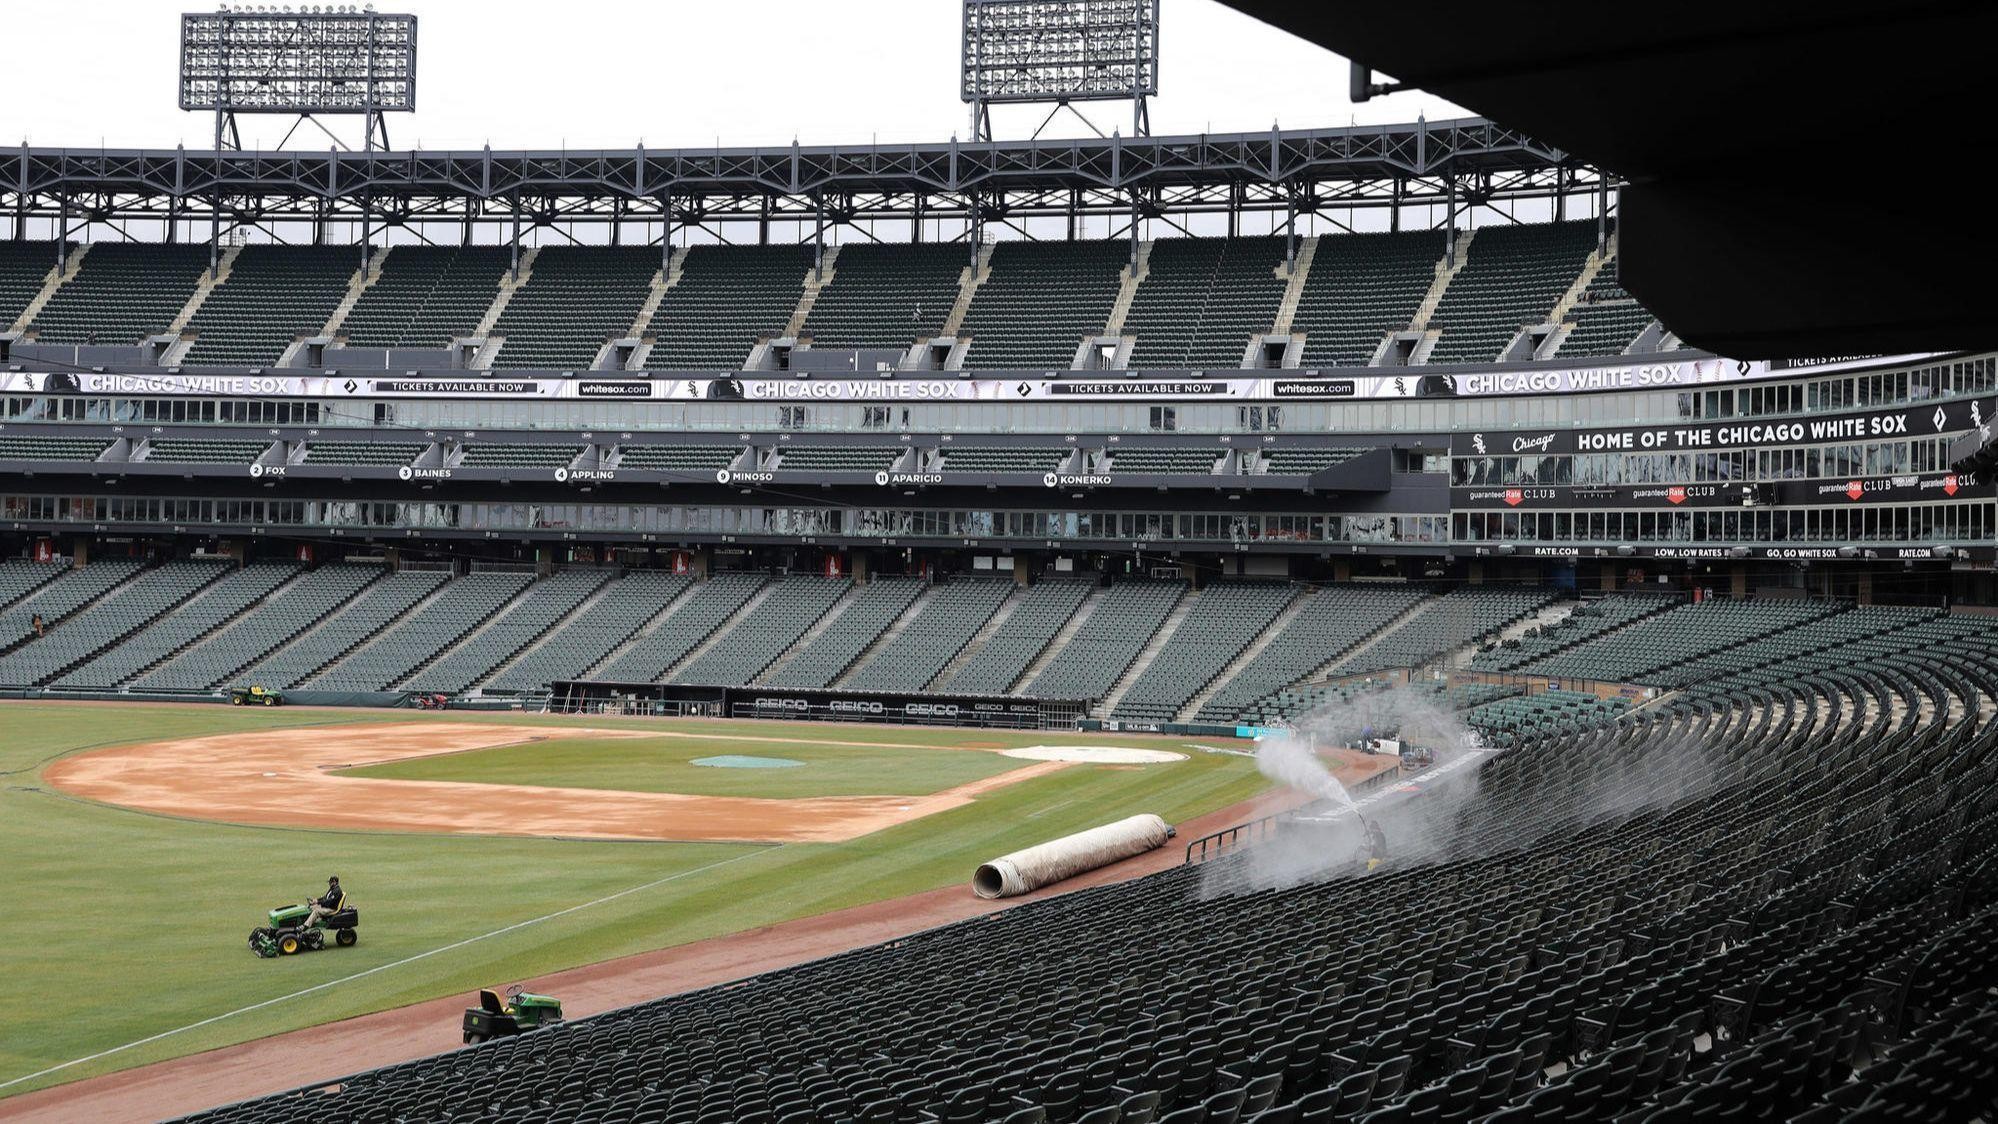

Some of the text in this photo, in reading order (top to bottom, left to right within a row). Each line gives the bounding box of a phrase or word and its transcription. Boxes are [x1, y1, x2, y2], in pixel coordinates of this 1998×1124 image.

[1464, 363, 1684, 394] CHICAGO WHITE SOX
[88, 375, 289, 394] CHICAGO WHITE SOX
[392, 382, 524, 392] TICKETS AVAILABLE NOW
[582, 384, 649, 394] whitesox.com
[1068, 384, 1212, 393] TICKETS AVAILABLE NOW
[1277, 384, 1351, 394] whitesox.com
[751, 381, 959, 399] CHICAGO WHITE SOX
[1578, 414, 1907, 450] HOME OF THE CHICAGO WHITE SOX
[1512, 432, 1556, 452] Chicago
[265, 466, 286, 475] FOX
[414, 469, 451, 478] BAINES
[570, 471, 615, 480] APPLING
[732, 472, 774, 481] MINOSO
[892, 474, 942, 483] APARICIO
[1060, 475, 1112, 485] KONERKO
[1958, 473, 1978, 486] CLU
[1818, 482, 1849, 494] guaranteed
[1849, 481, 1862, 490] Rate
[1863, 479, 1892, 492] CLUB
[1469, 489, 1556, 500] guaranteed Rate CLUB
[1633, 486, 1715, 499] guaranteed Rate CLUB
[1534, 547, 1579, 555] RATE.COM
[1654, 548, 1722, 558] LOW, LOW RATES
[1766, 549, 1837, 559] GO, GO WHITE SOX
[1898, 548, 1931, 558] RATE.COM
[755, 697, 808, 710] GEICO
[830, 700, 883, 713] GEICO
[905, 702, 959, 716] GEICO
[974, 703, 1004, 711] GEICO
